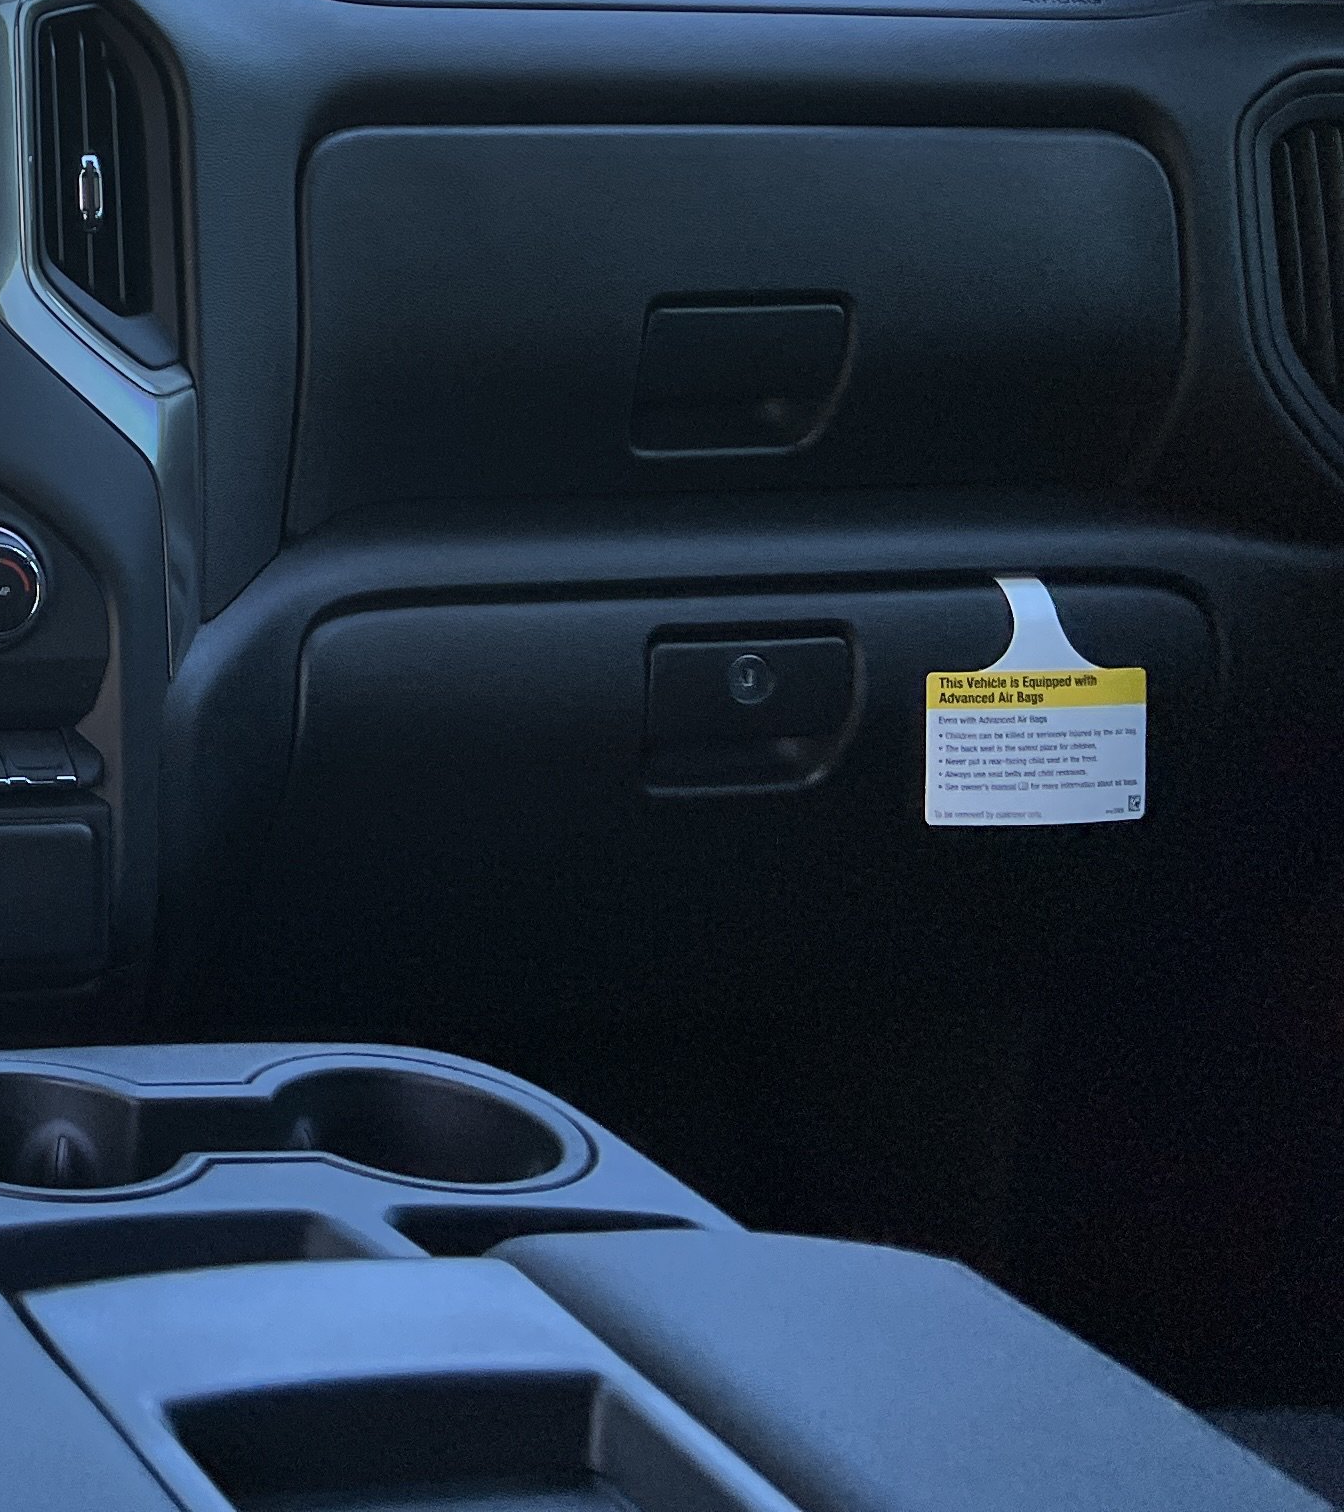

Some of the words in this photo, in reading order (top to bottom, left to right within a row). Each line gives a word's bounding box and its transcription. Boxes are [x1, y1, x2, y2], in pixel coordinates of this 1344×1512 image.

[938, 677, 964, 689] This
[967, 677, 1007, 689] Vehicle
[1010, 676, 1020, 689] is
[1023, 675, 1072, 691] Equipped
[1075, 674, 1097, 687] with
[939, 692, 995, 705] Advanced
[999, 691, 1014, 704] Air
[1017, 691, 1045, 706] Bags
[938, 716, 958, 725] Even
[960, 716, 977, 724] with
[979, 716, 1016, 724] Advanced
